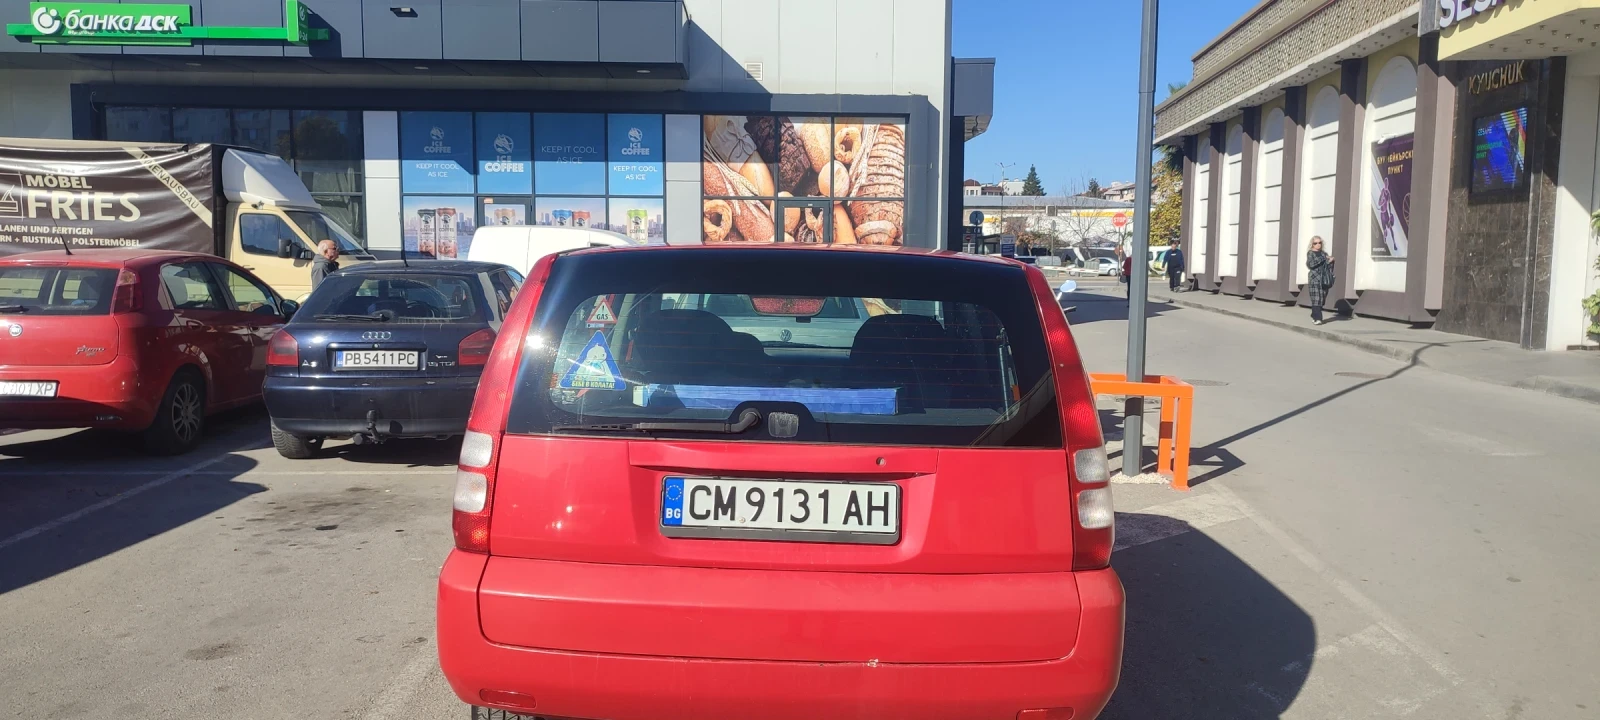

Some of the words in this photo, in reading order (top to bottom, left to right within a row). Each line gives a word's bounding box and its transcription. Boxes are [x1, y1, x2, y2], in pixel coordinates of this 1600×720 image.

[65, 9, 134, 31] банка
[1469, 60, 1525, 95] KYUCHUK
[484, 162, 524, 172] COFFEE
[25, 173, 92, 189] MÖBEL
[27, 189, 141, 222] FRIES
[52, 226, 93, 235] FERTIGEN
[22, 236, 64, 245] RUSTIKAL
[72, 237, 140, 247] POLSTERMÖBEL
[344, 353, 361, 365] PB
[363, 353, 394, 365] 5411
[399, 353, 415, 365] PC
[689, 485, 737, 521] CM
[745, 487, 829, 524] 9131
[842, 490, 889, 526] AH
[665, 508, 681, 519] BG
